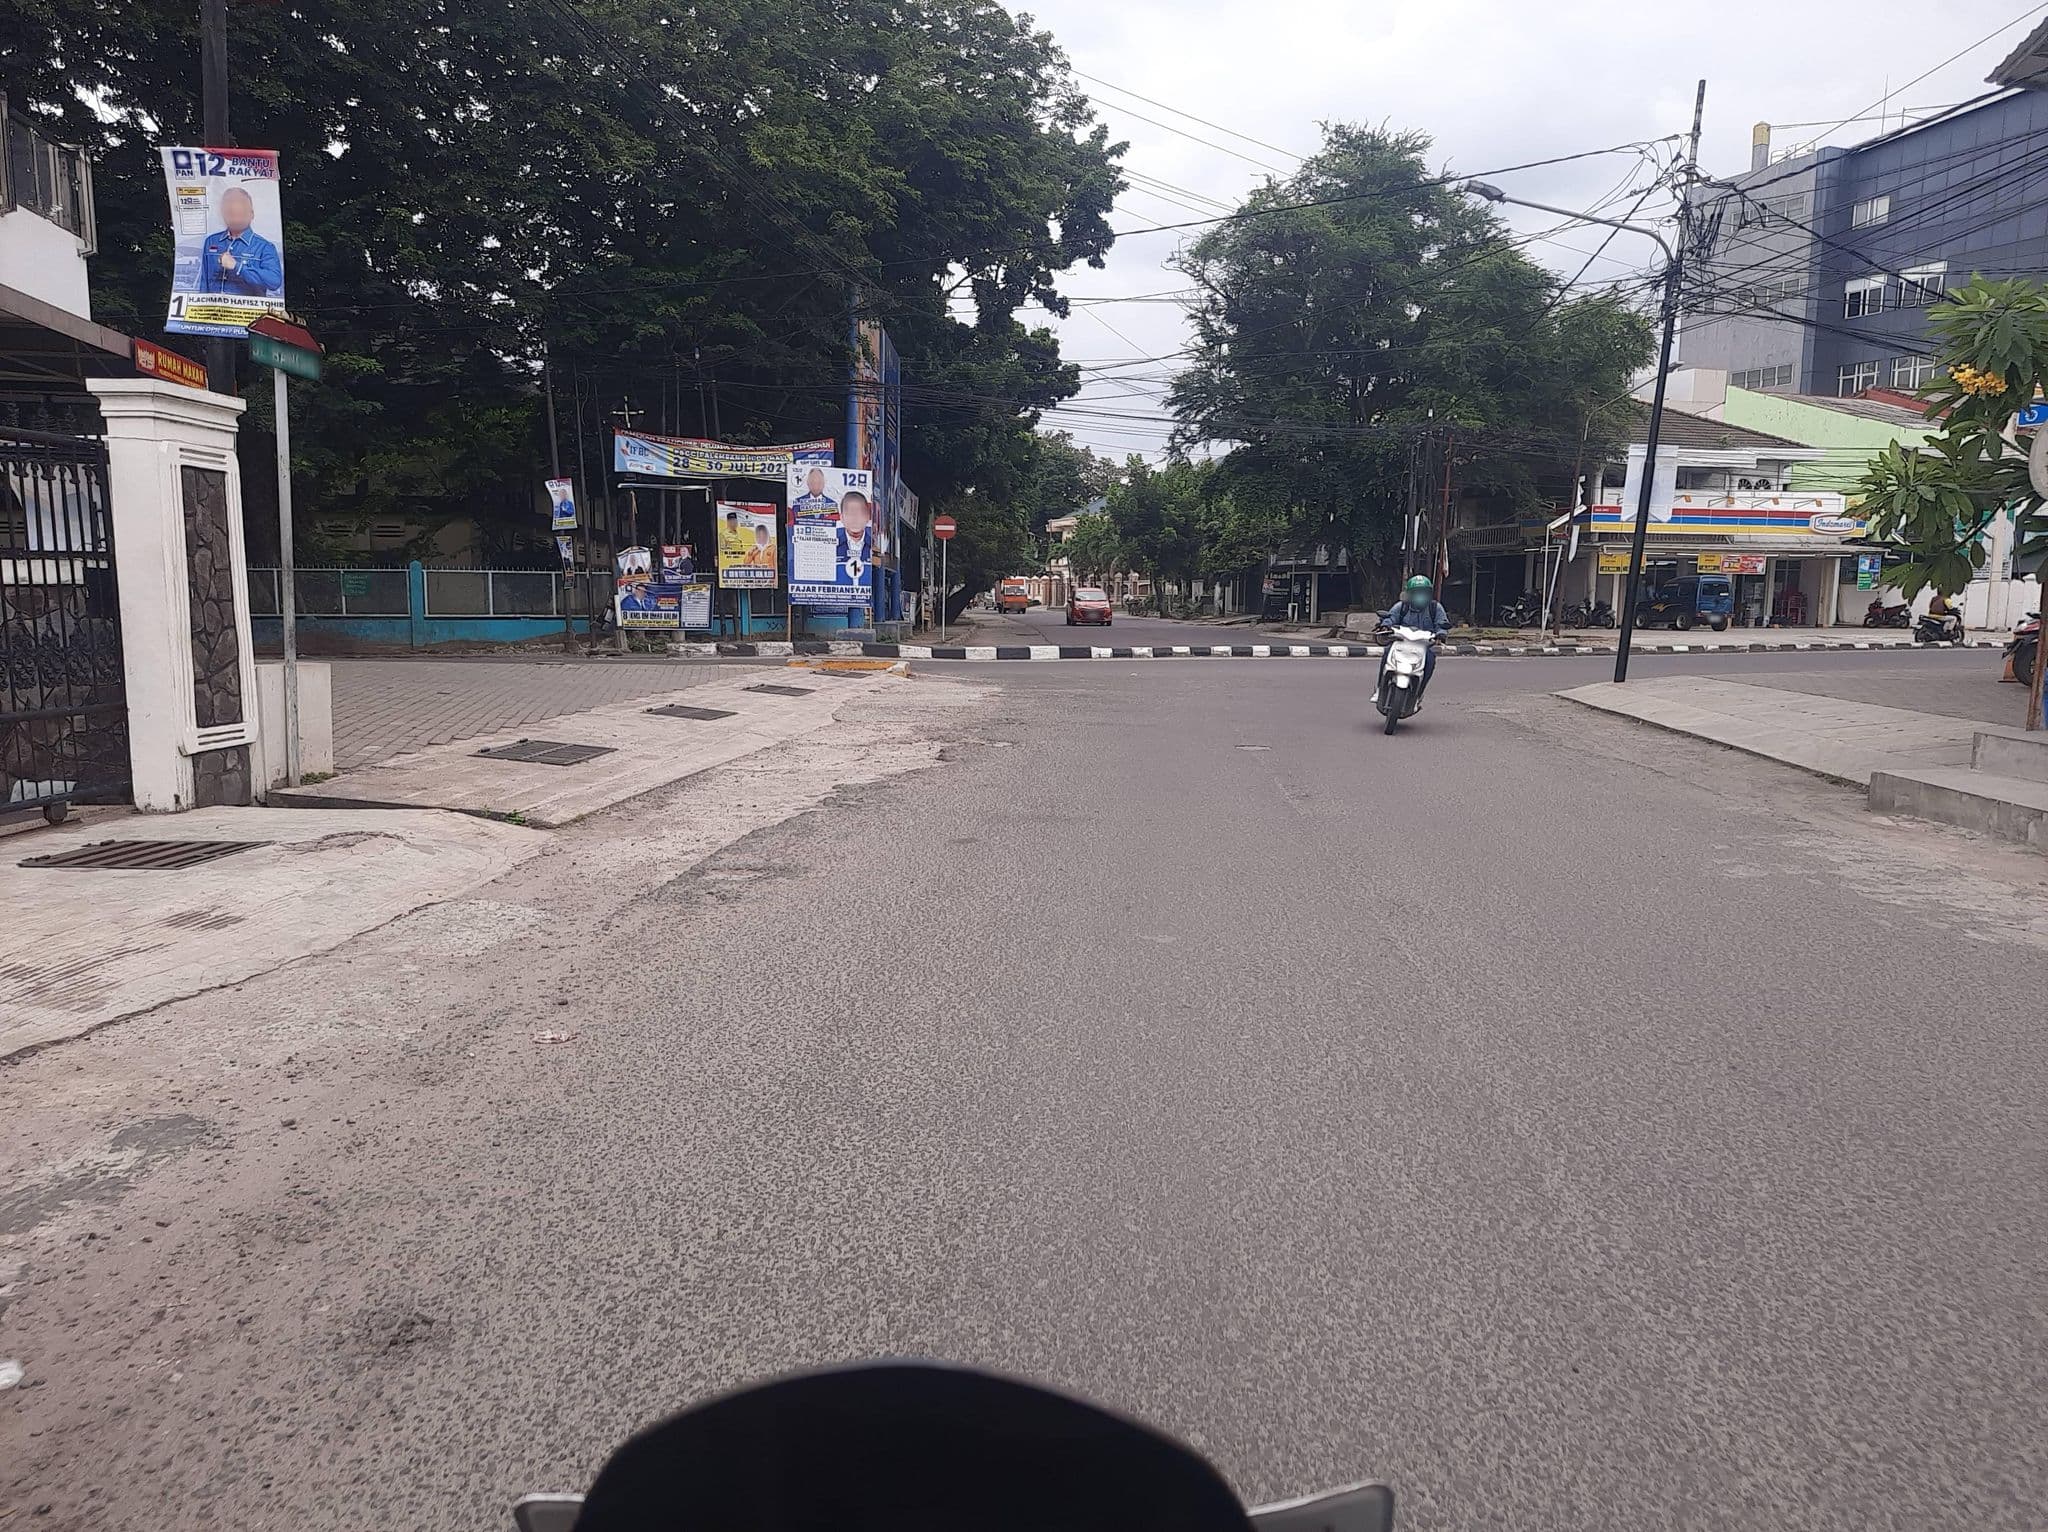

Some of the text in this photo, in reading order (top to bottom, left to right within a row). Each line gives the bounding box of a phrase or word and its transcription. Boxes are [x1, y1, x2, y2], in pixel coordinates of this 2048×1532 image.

[194, 153, 226, 176] 12
[231, 157, 269, 167] BANTU
[229, 167, 274, 177] RAKYAT
[171, 295, 184, 318] 1
[157, 351, 181, 375] RUMAH
[183, 362, 204, 385] MAKAN
[673, 457, 690, 468] 28
[706, 460, 723, 471] 30
[728, 463, 755, 473] JULI
[842, 473, 857, 486] 12
[850, 560, 858, 577] 1
[790, 585, 871, 594] FAJAR FEBRIANSYAH
